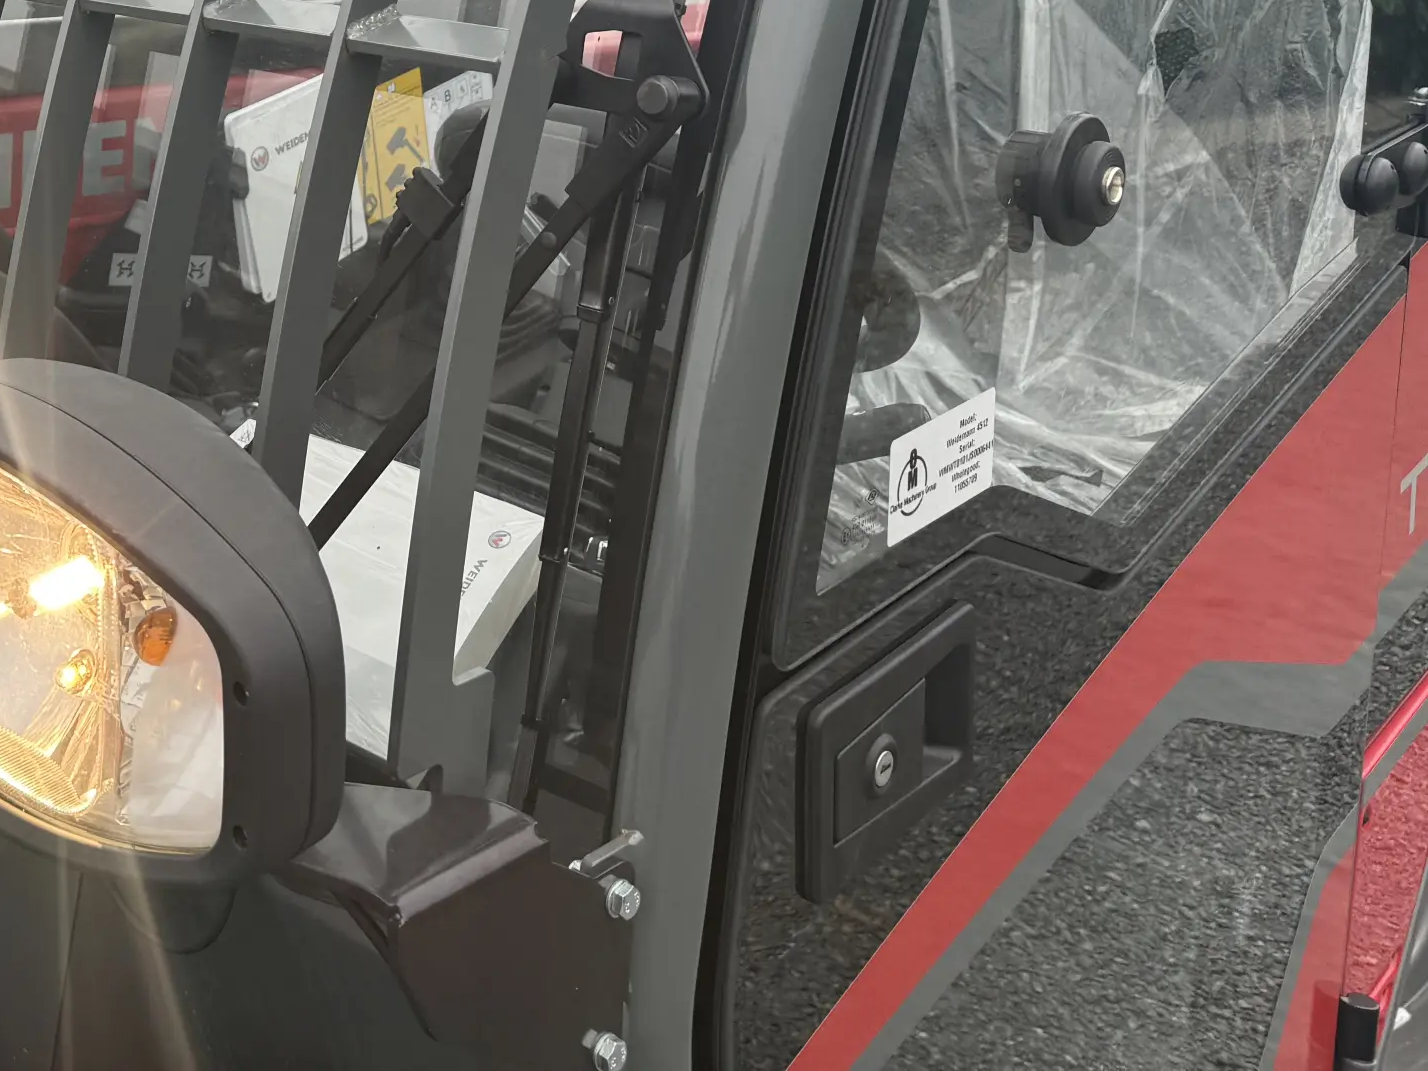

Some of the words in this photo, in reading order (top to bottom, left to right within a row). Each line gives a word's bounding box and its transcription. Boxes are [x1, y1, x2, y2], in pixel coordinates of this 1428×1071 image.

[444, 90, 452, 102] B
[274, 131, 311, 156] WEIDE
[959, 412, 977, 429] Model:
